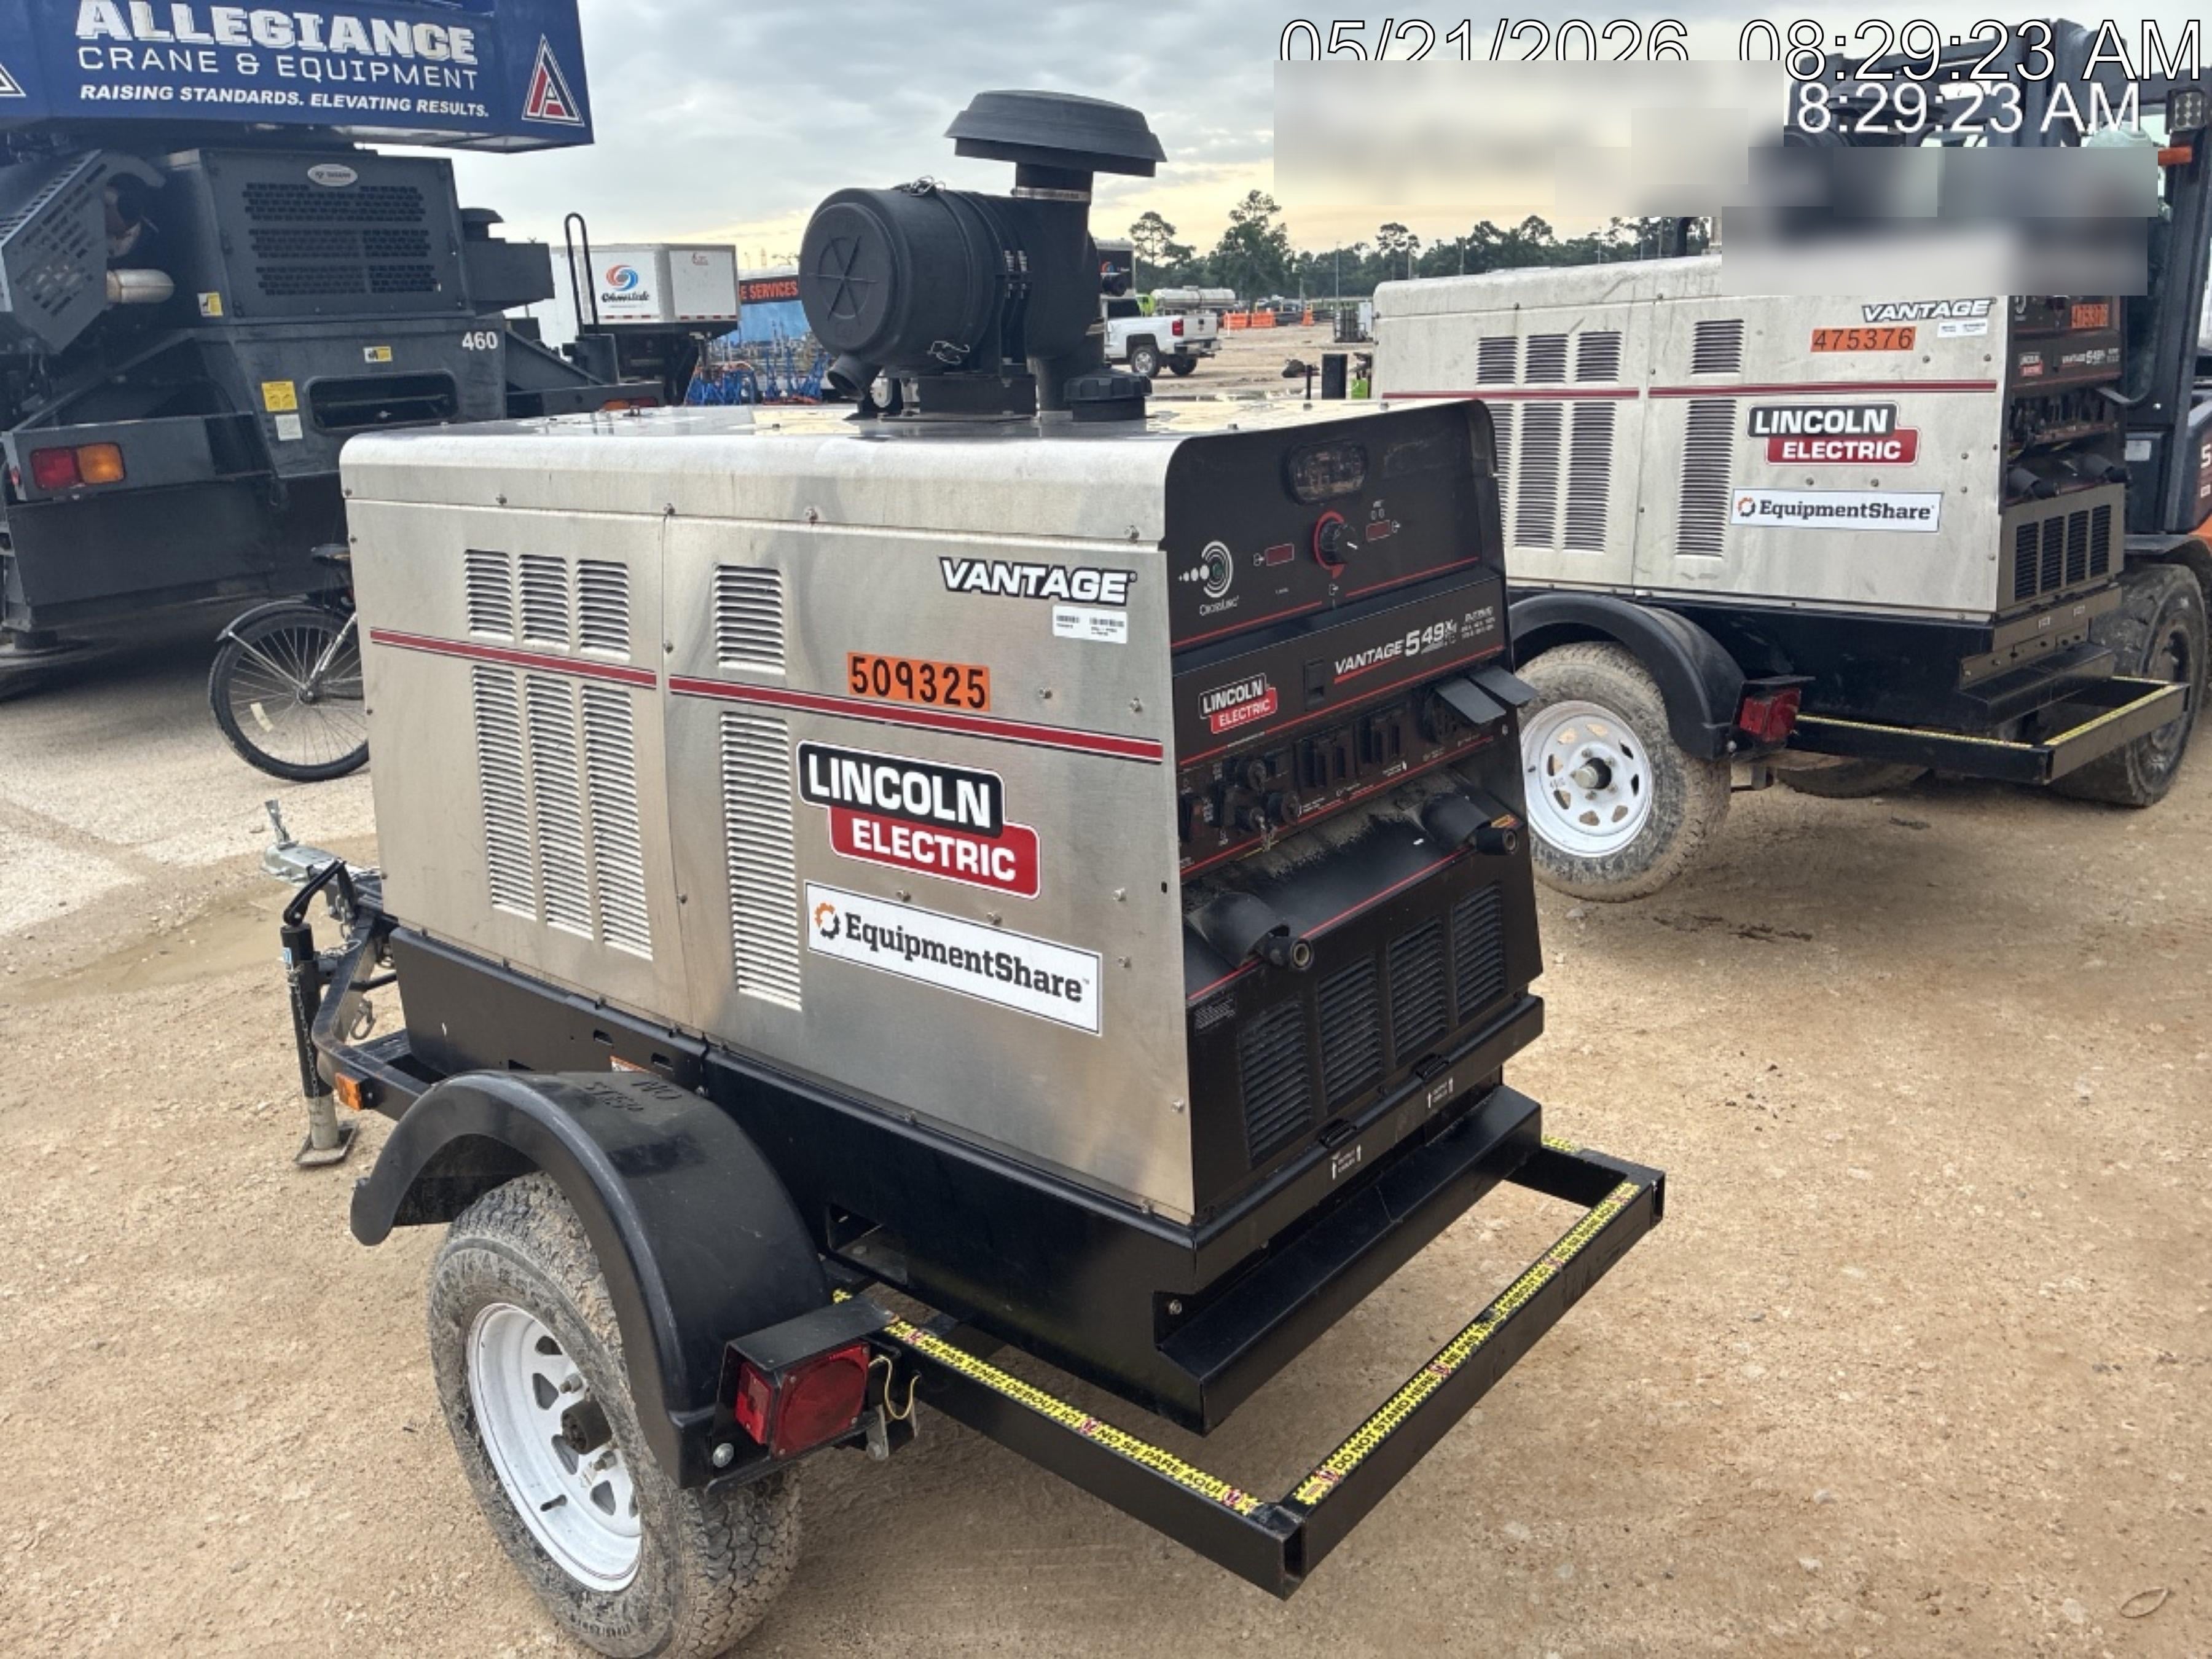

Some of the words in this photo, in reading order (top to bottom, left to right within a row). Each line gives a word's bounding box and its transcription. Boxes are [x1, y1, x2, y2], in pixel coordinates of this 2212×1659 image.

[75, 0, 478, 65] ALLEGIANCE
[78, 47, 219, 73] CRANE
[236, 53, 260, 74] &
[276, 55, 477, 90] EQUIPMENT
[80, 84, 173, 101] RAISING
[180, 87, 304, 106] STANDARDS.
[310, 93, 411, 112] ELEVATING
[416, 100, 489, 117] RESULTS.
[750, 280, 798, 299] SERVICES
[1862, 299, 1991, 322] VANTAGE
[462, 331, 498, 351] 460
[1813, 327, 1913, 351] 475376
[1754, 408, 1888, 434] LINCOLN
[1782, 440, 1902, 460] ELECTRIC
[1759, 499, 1931, 520] EquipmentShare
[939, 557, 1129, 606] VANTAGE
[1334, 639, 1405, 675] VANTAGE
[852, 656, 986, 708] 509325
[1202, 678, 1263, 713] LINCOLN
[1219, 698, 1271, 728] ELECTRIC
[808, 753, 991, 829] LINCOLN
[852, 817, 1016, 882] ELECTRIC
[845, 912, 1083, 1003] EquipmentShare
[1005, 1382, 1059, 1411] DEBOUT
[1333, 1453, 1354, 1469] DO
[1351, 1430, 1378, 1454] NOT
[1373, 1398, 1411, 1432] STAND
[1406, 1374, 1439, 1400] HERE
[1097, 1429, 1120, 1443] NO
[1120, 1440, 1142, 1454] SE
[1142, 1449, 1185, 1475] PARE
[1185, 1472, 1223, 1494] AQUI
